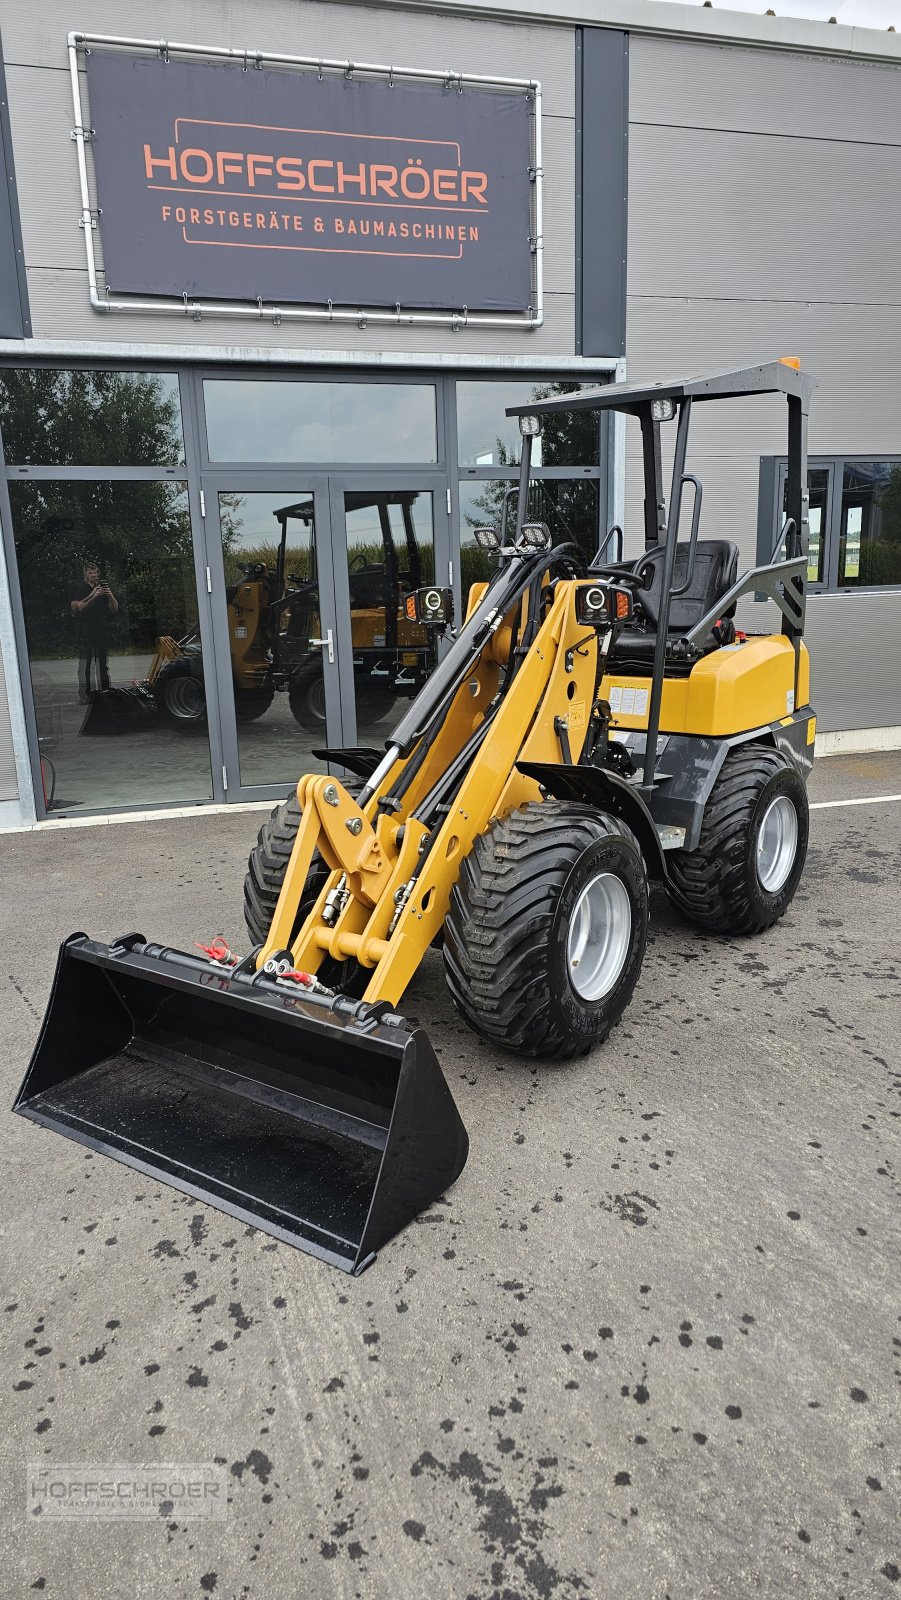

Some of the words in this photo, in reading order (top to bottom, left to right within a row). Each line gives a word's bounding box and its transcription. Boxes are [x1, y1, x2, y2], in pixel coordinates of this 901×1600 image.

[143, 144, 489, 204] HOFFSCHRÖER
[161, 205, 303, 232] FORSTGERÄTE
[313, 217, 324, 233] &
[334, 218, 480, 242] BAUMASCHINEN
